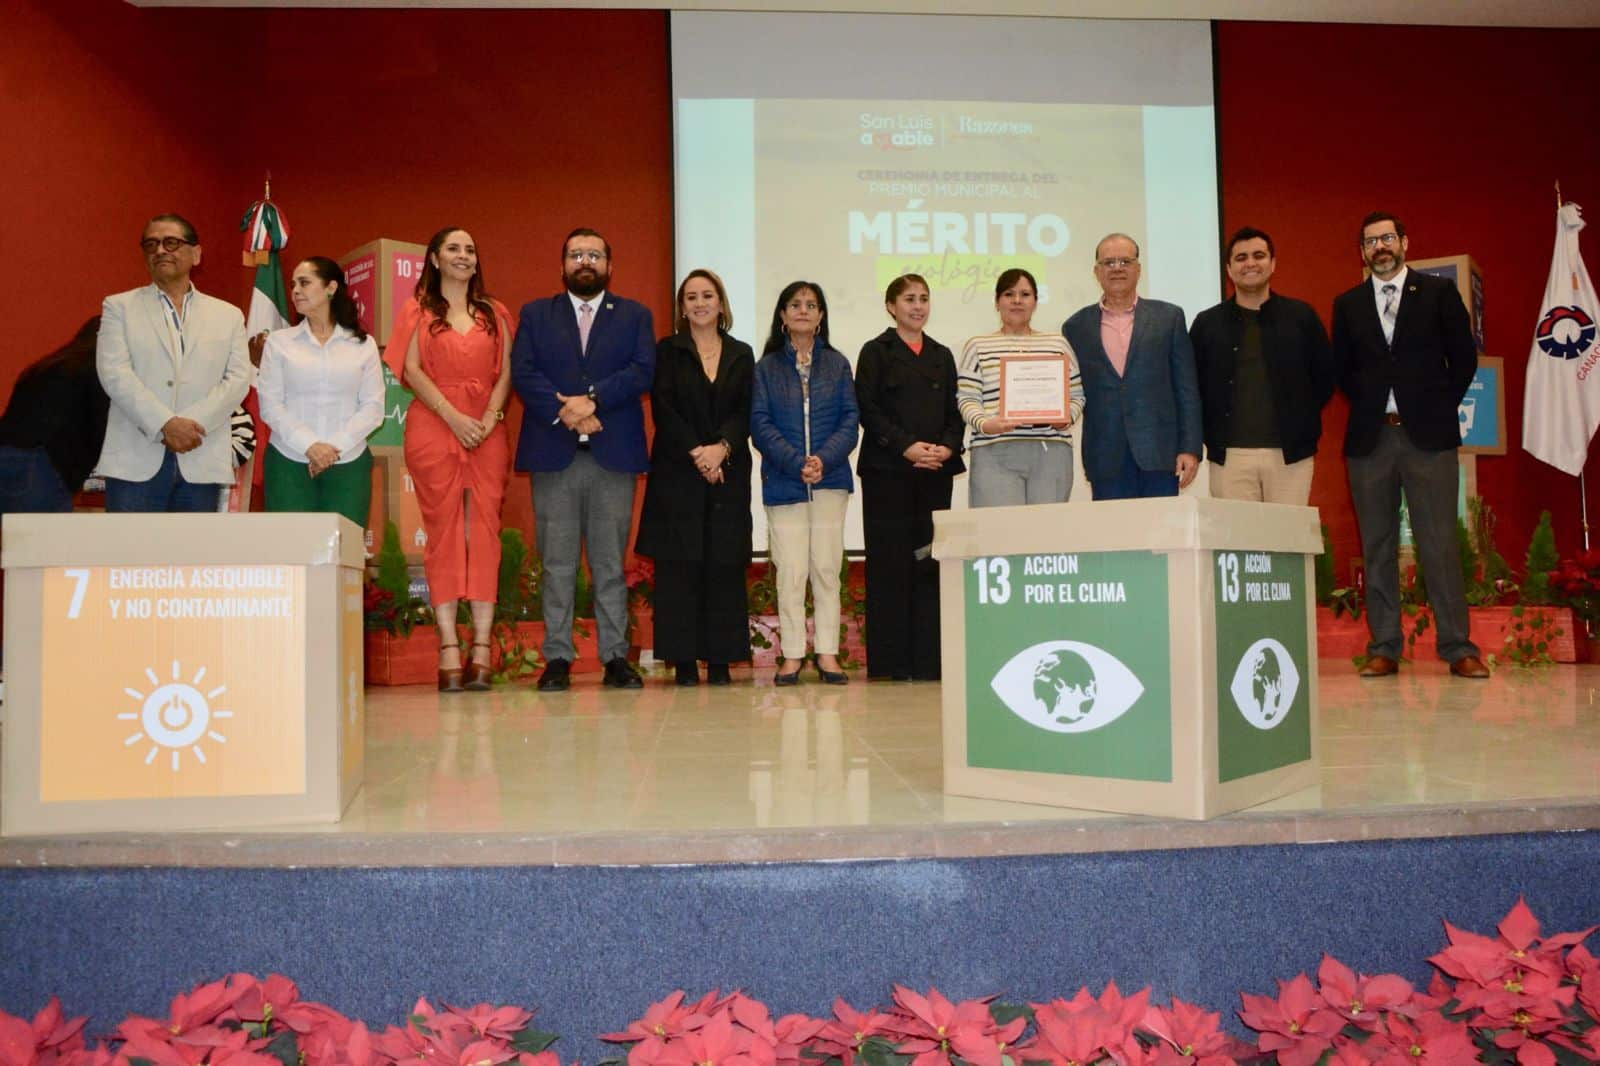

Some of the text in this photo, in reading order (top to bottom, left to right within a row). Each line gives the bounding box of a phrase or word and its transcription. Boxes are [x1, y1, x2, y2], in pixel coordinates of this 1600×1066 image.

[860, 113, 933, 129] San Luis
[943, 171, 960, 181] DE
[869, 183, 1040, 197] PREMIO MUNICIPAL AL
[848, 198, 1071, 257] MÉRITO
[396, 258, 411, 278] 10
[899, 246, 1000, 304] ecológic
[1024, 553, 1079, 575] ACCIÓN
[1245, 552, 1271, 573] ACCIÓN
[109, 564, 285, 589] ENERGÍA ASEQUIBLE
[972, 557, 1012, 605] 13
[1218, 553, 1239, 602] 13
[64, 569, 90, 619] 7
[1025, 582, 1127, 604] POR EL CLIMA
[1245, 582, 1291, 602] POR EL CLIMA
[109, 598, 293, 619] Y NO CONTAMINANTE
